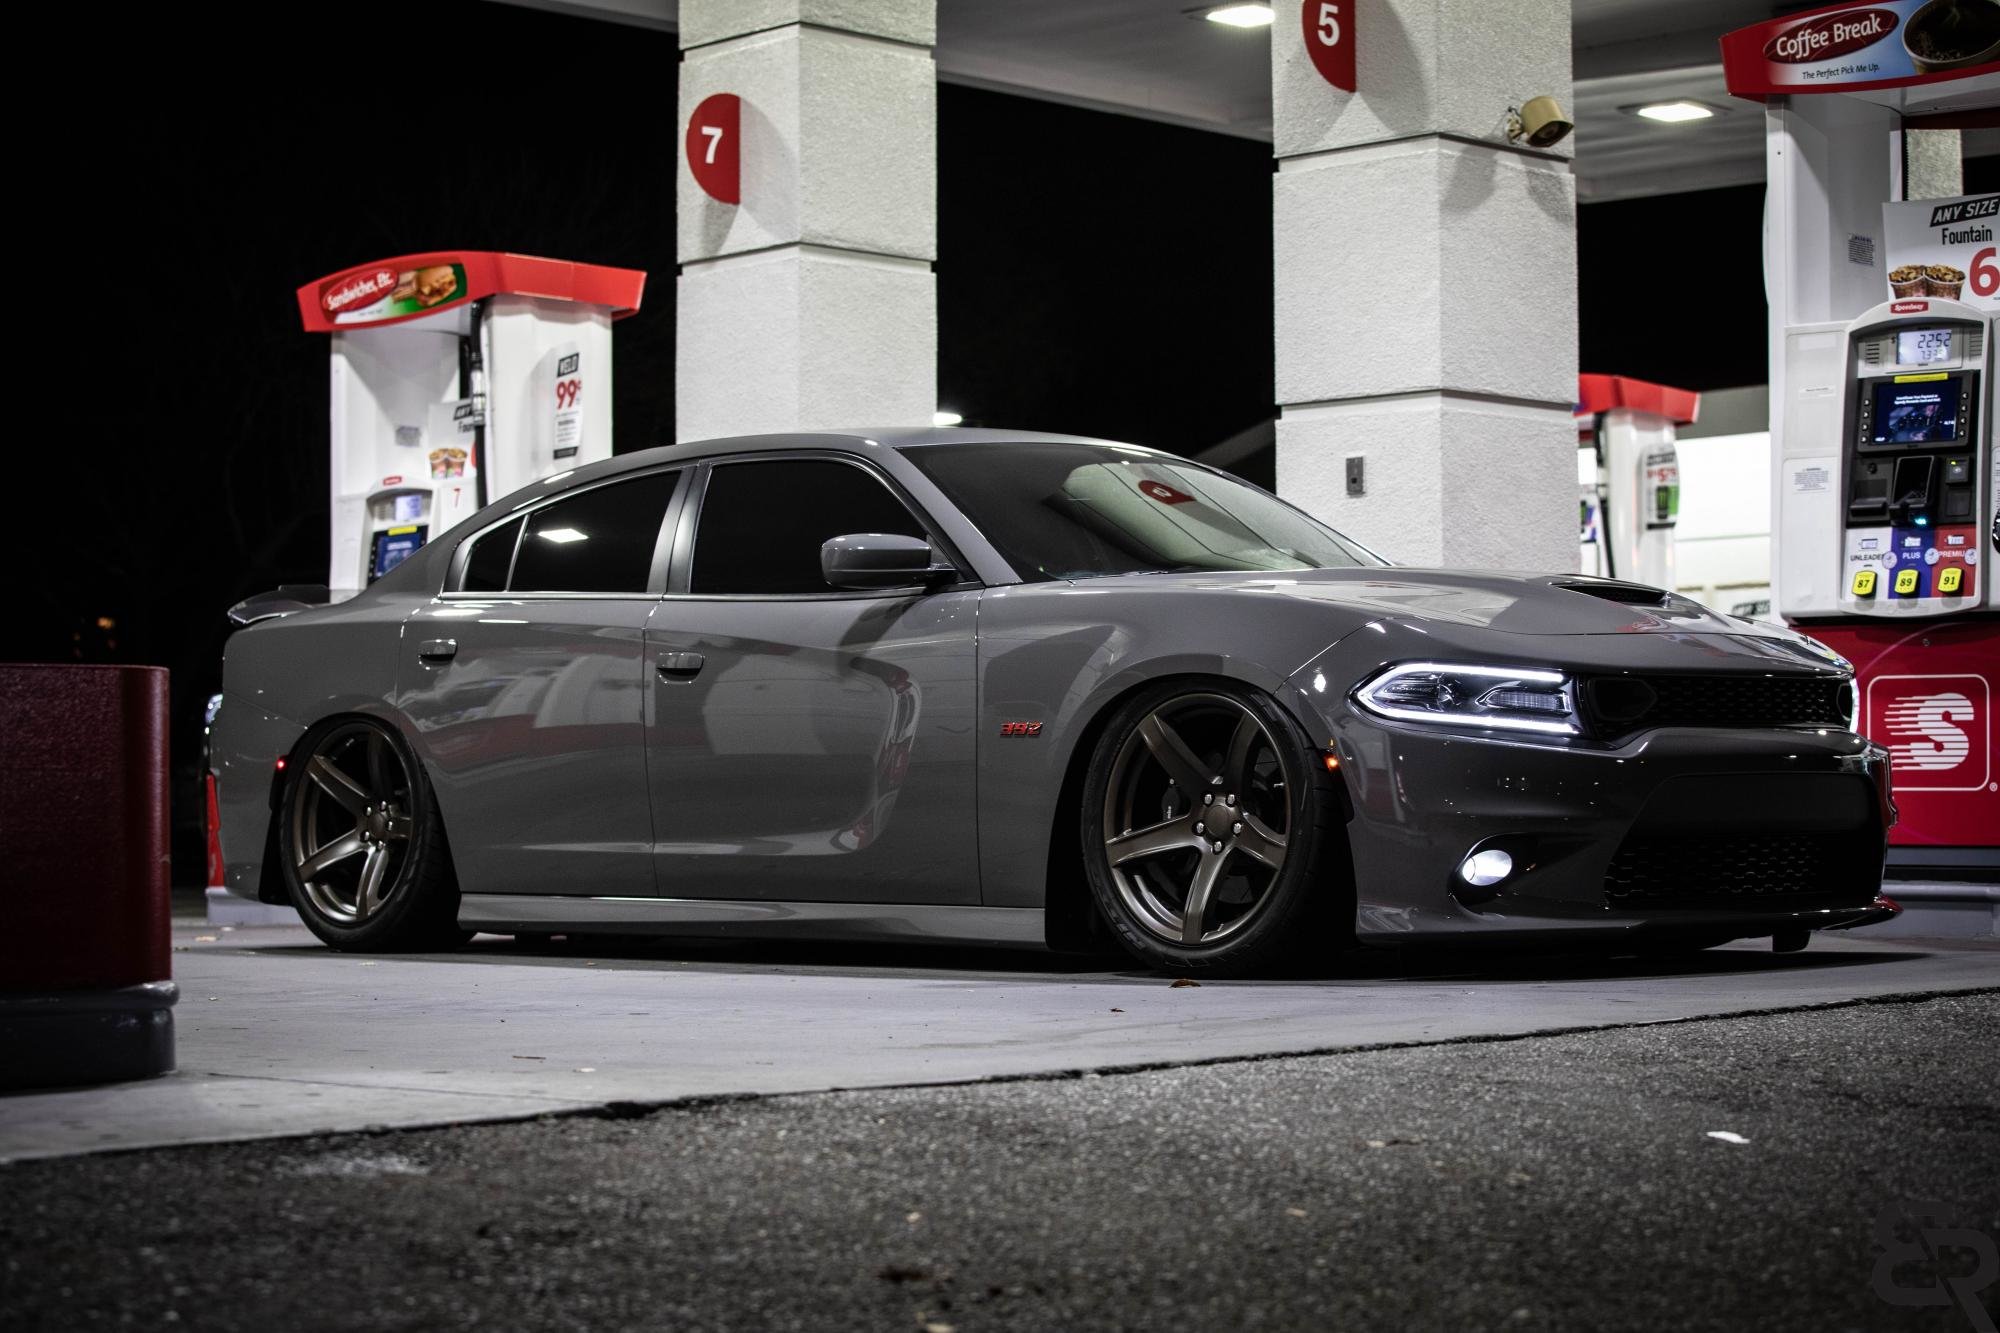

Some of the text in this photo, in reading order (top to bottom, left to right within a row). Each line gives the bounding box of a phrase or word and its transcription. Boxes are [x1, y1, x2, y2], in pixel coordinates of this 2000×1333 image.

[1317, 2, 1340, 47] 5
[1776, 13, 1882, 58] Coffee Break
[1803, 71, 1815, 80] The
[1816, 68, 1840, 80] Perfect
[1841, 66, 1855, 75] Pick
[1856, 65, 1867, 73] Me
[701, 126, 723, 164] 7
[1933, 199, 1999, 224] ANY SIZE
[1941, 224, 1993, 246] Fountain
[1850, 553, 1884, 562] UNLEADE
[1902, 552, 1921, 560] PLUS
[1857, 579, 1870, 588] 87
[1899, 578, 1913, 587] 89
[1943, 575, 1955, 585] 91
